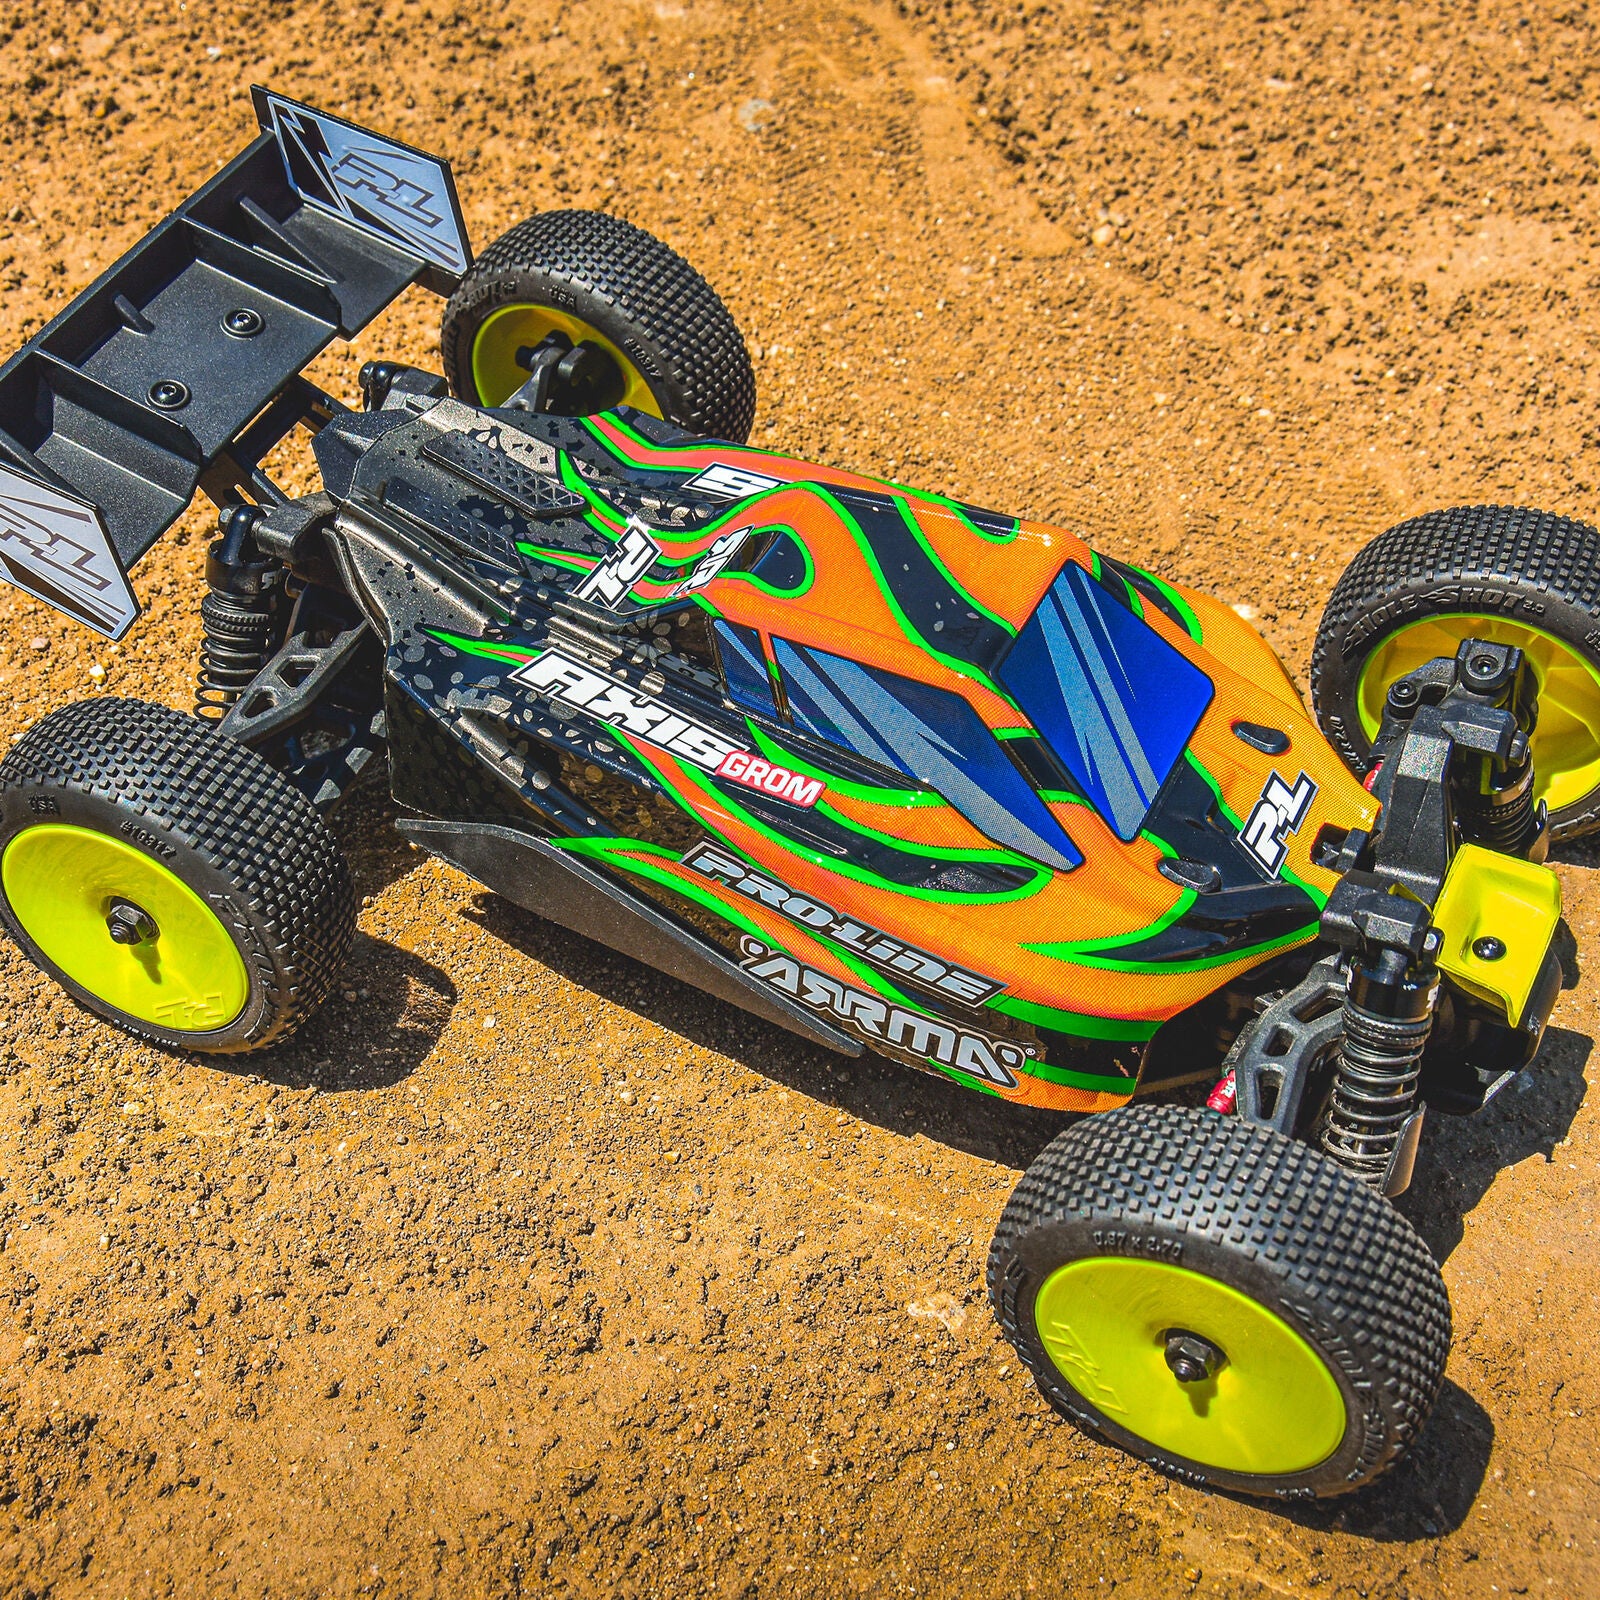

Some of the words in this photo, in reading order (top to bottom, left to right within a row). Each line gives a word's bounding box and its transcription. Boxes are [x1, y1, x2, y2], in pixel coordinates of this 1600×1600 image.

[511, 649, 742, 772] AXIS
[720, 753, 823, 804] GROM
[687, 848, 997, 1002] PRO-LINE
[1147, 1236, 1184, 1257] 2.70
